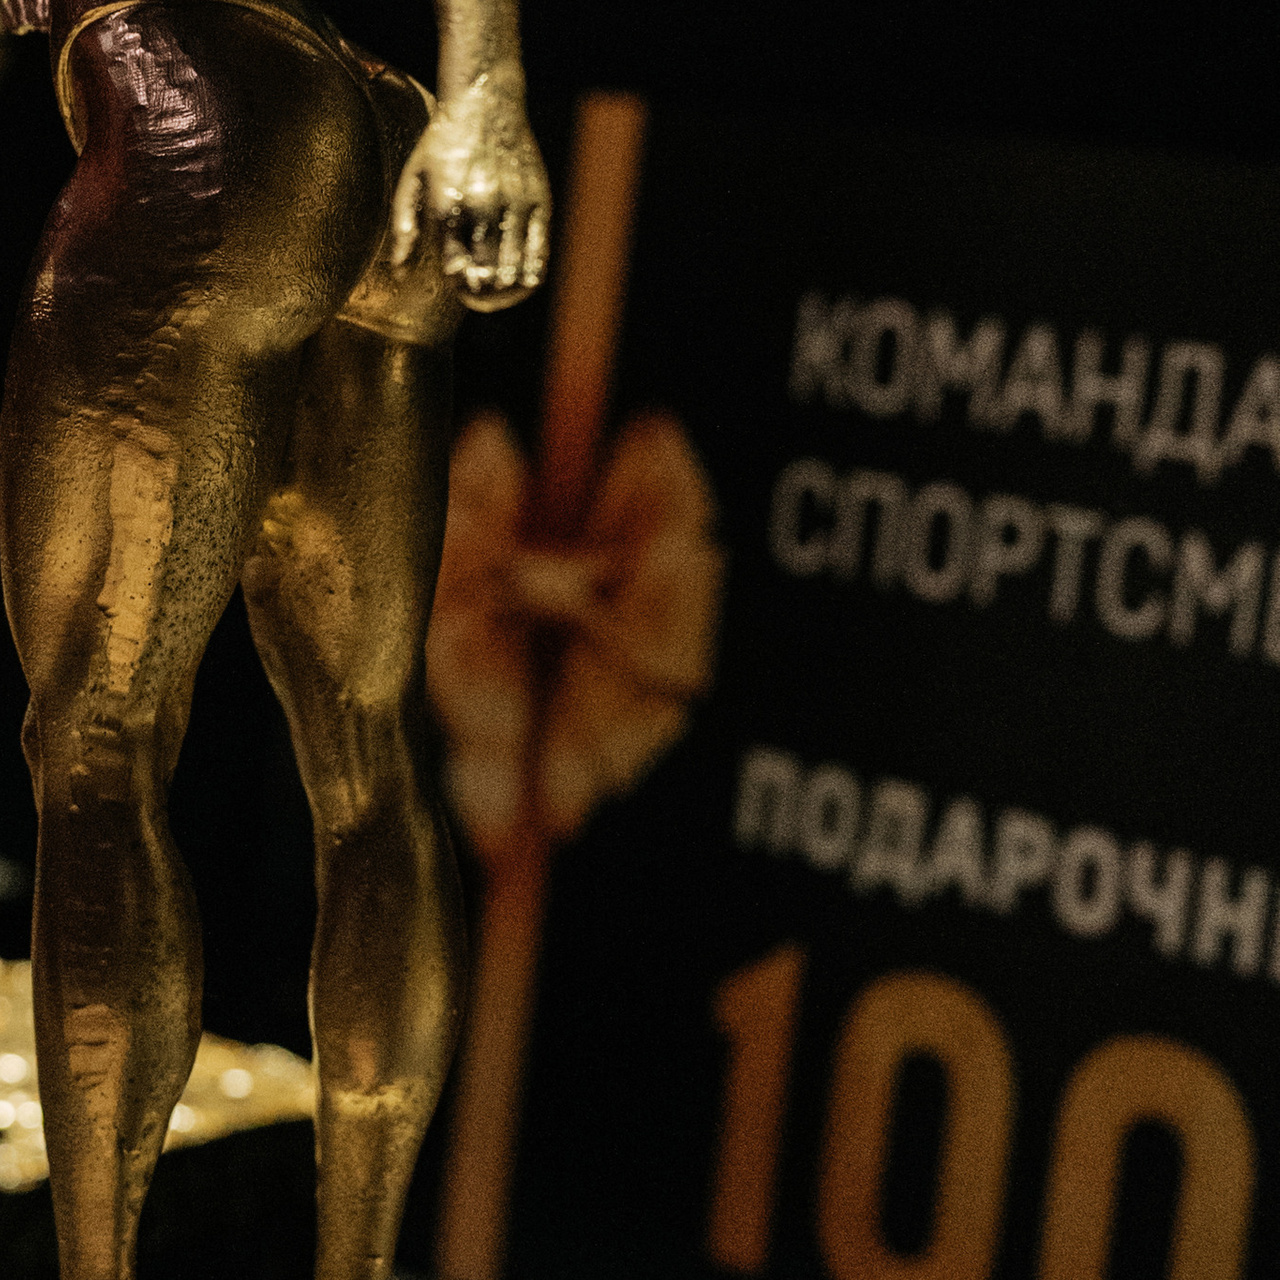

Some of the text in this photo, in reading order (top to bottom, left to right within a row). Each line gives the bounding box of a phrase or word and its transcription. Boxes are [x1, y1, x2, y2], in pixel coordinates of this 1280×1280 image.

[788, 293, 1280, 484] КОМАНДА
[768, 459, 1280, 667] СПОРТСМ
[734, 745, 1280, 984] ПОДАРОЧН
